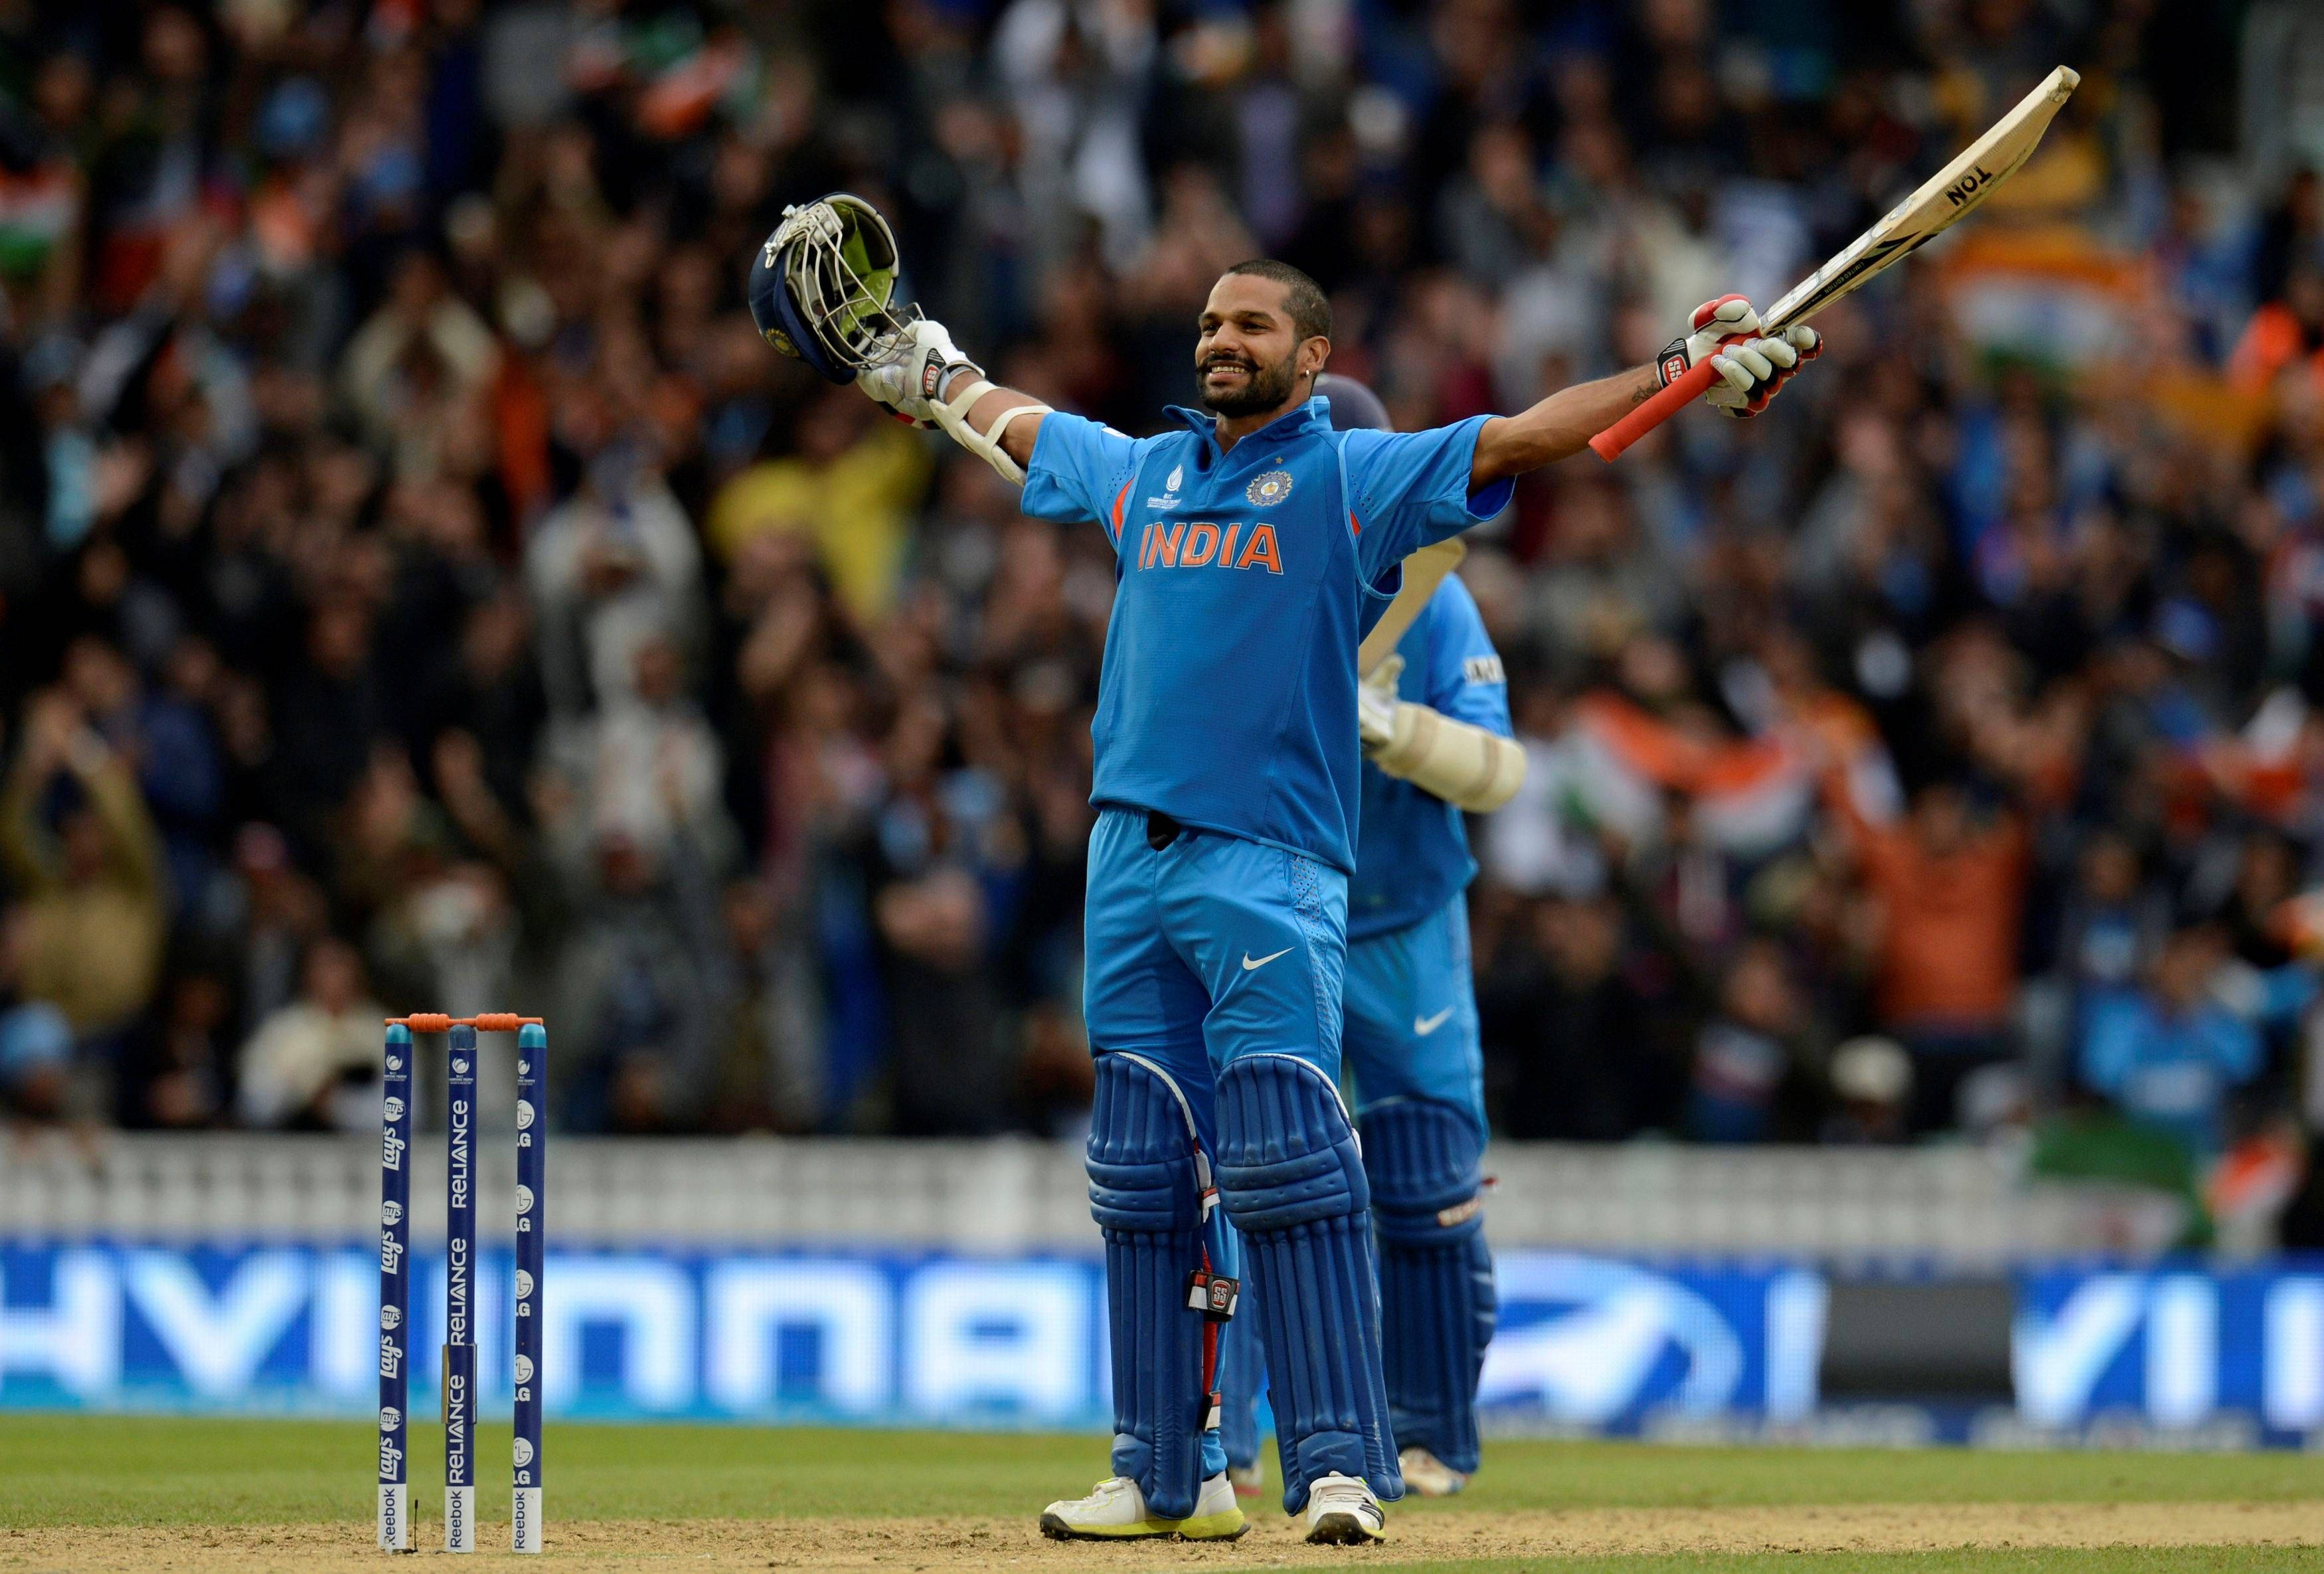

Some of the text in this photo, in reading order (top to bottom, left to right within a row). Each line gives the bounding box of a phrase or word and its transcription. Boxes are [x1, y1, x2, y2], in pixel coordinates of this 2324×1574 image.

[1945, 165, 1993, 206] TON
[1137, 521, 1284, 576] INDIA
[1213, 1286, 1228, 1303] SS
[450, 1490, 462, 1547] Reebok
[515, 1492, 525, 1549] Reebok
